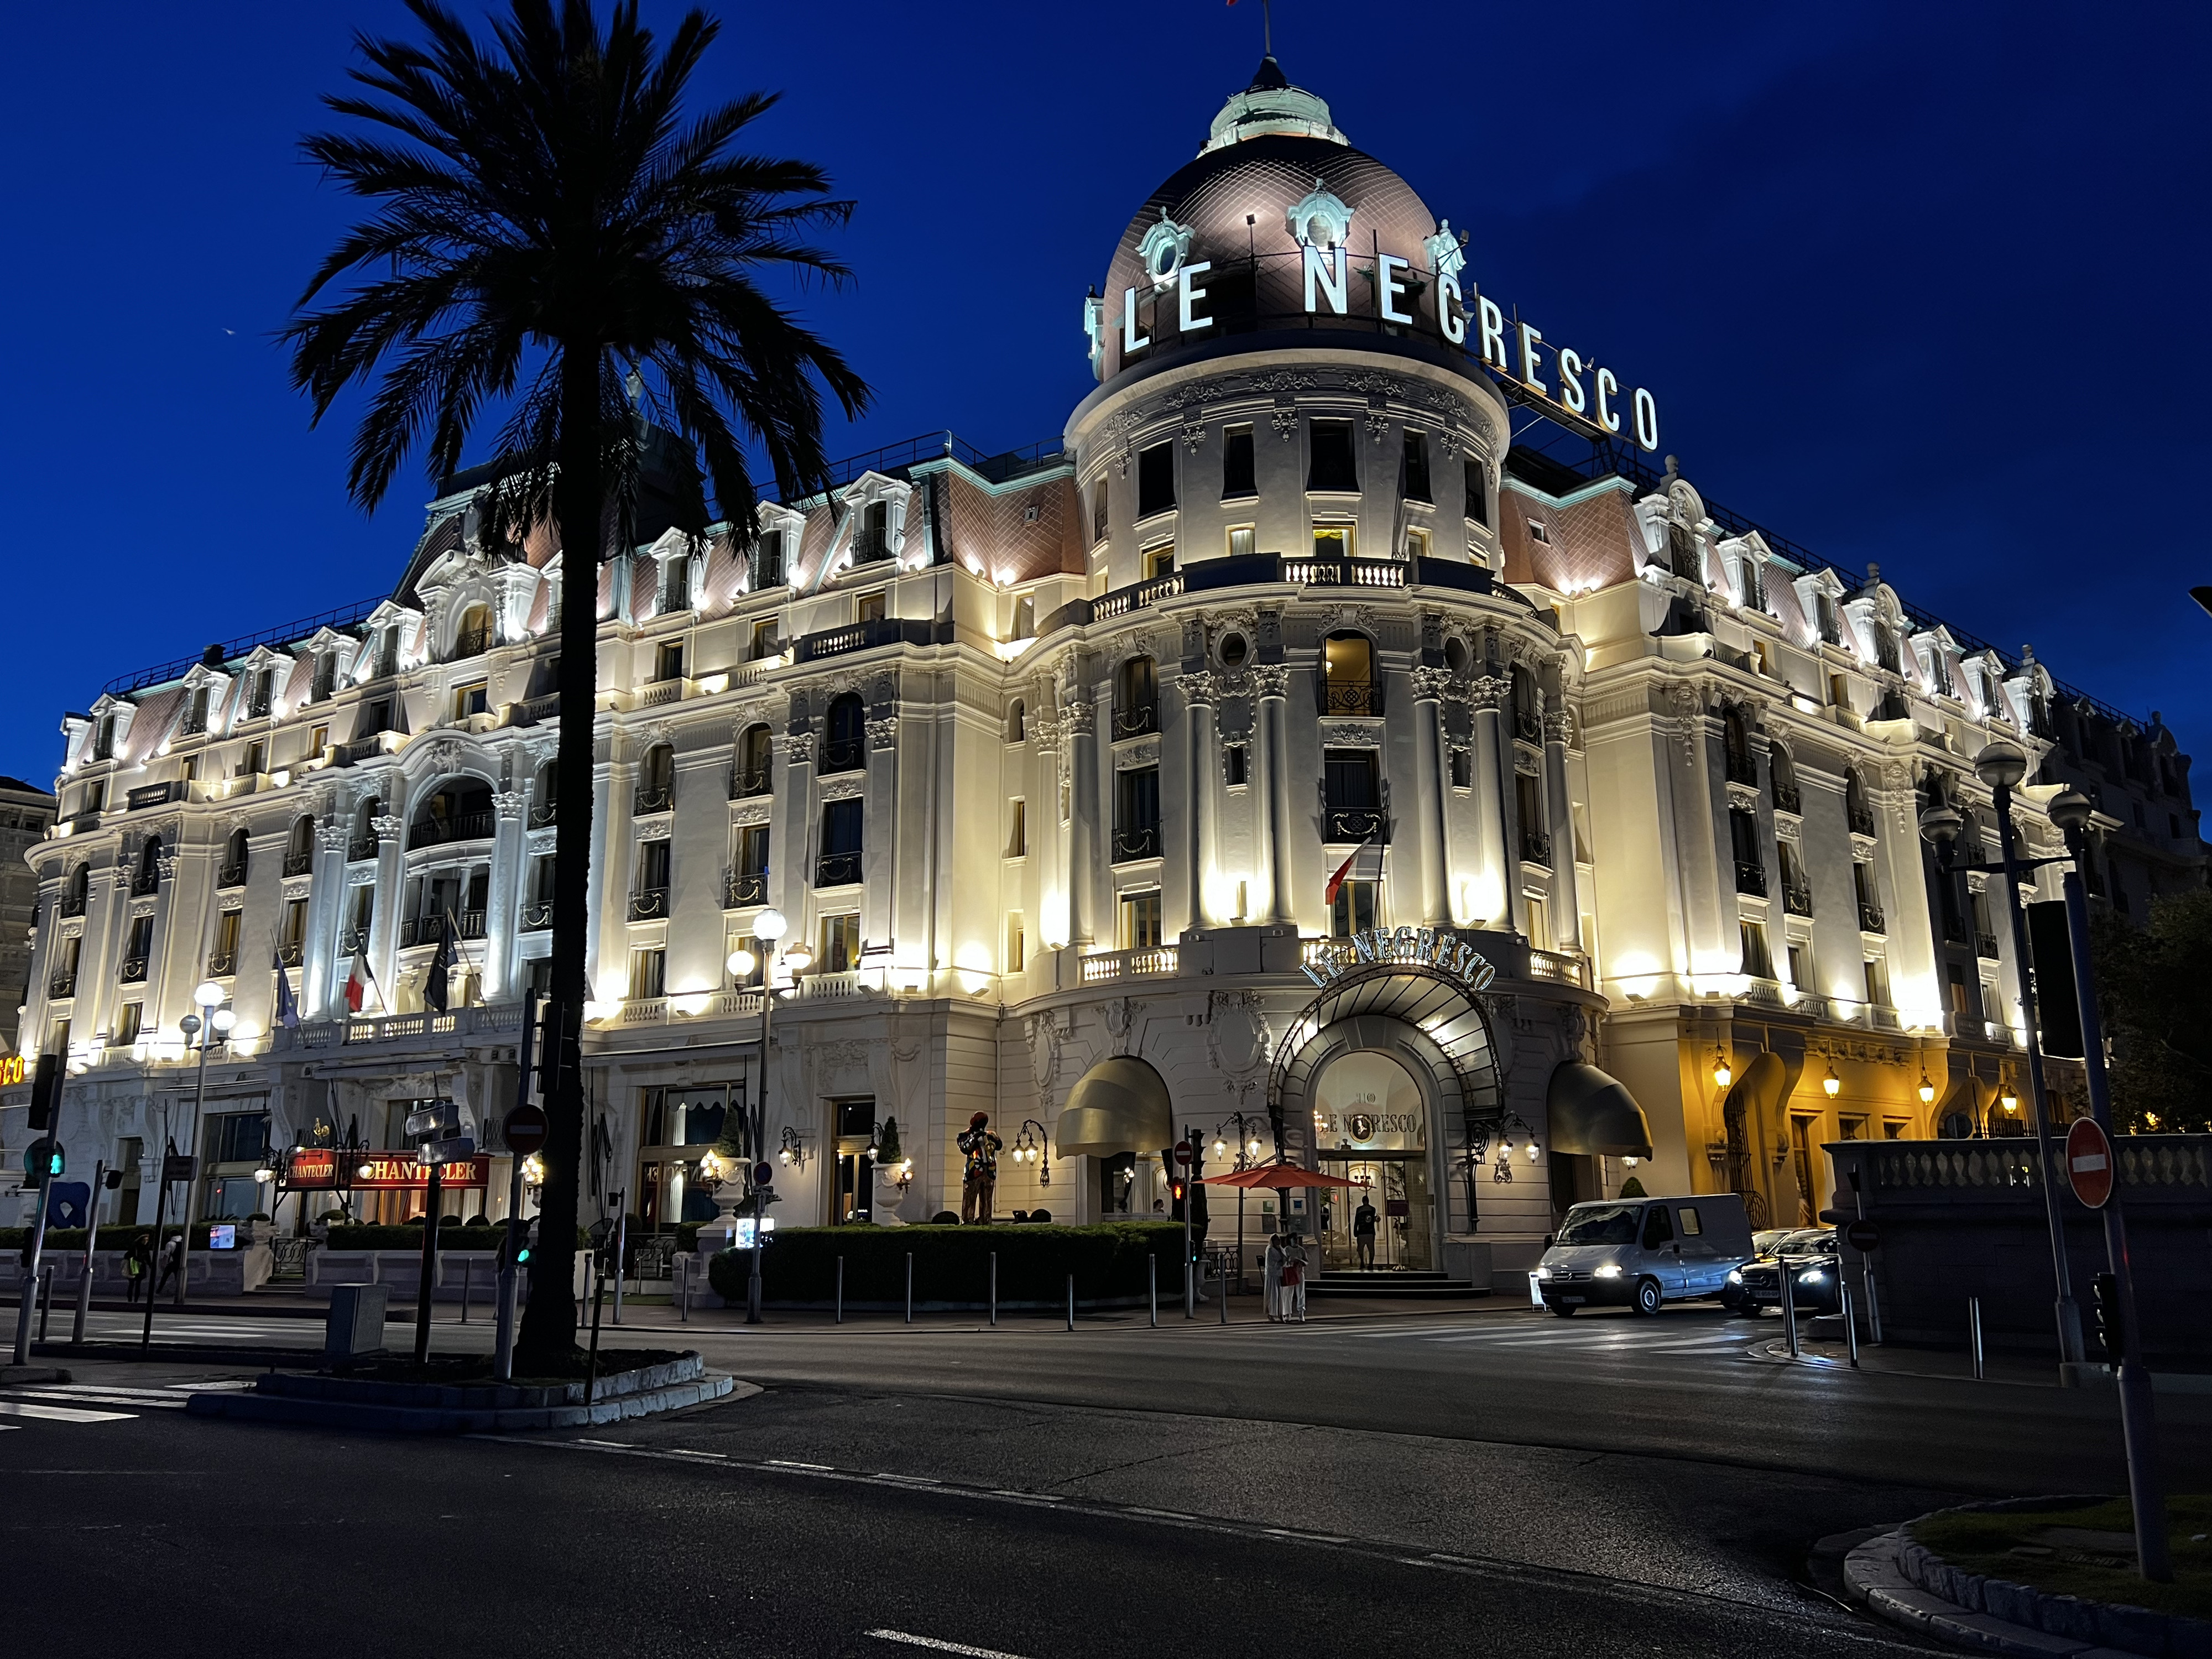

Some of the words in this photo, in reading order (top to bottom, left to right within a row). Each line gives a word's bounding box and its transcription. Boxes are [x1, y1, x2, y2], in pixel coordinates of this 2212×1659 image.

[1123, 260, 1213, 354] LE
[1301, 244, 1658, 452] NEGRESCO
[1299, 946, 1345, 989] LE
[1350, 926, 1496, 992] NEGRESCO
[1343, 1114, 1417, 1133] NRESCO
[288, 1164, 333, 1178] CHANTECLER
